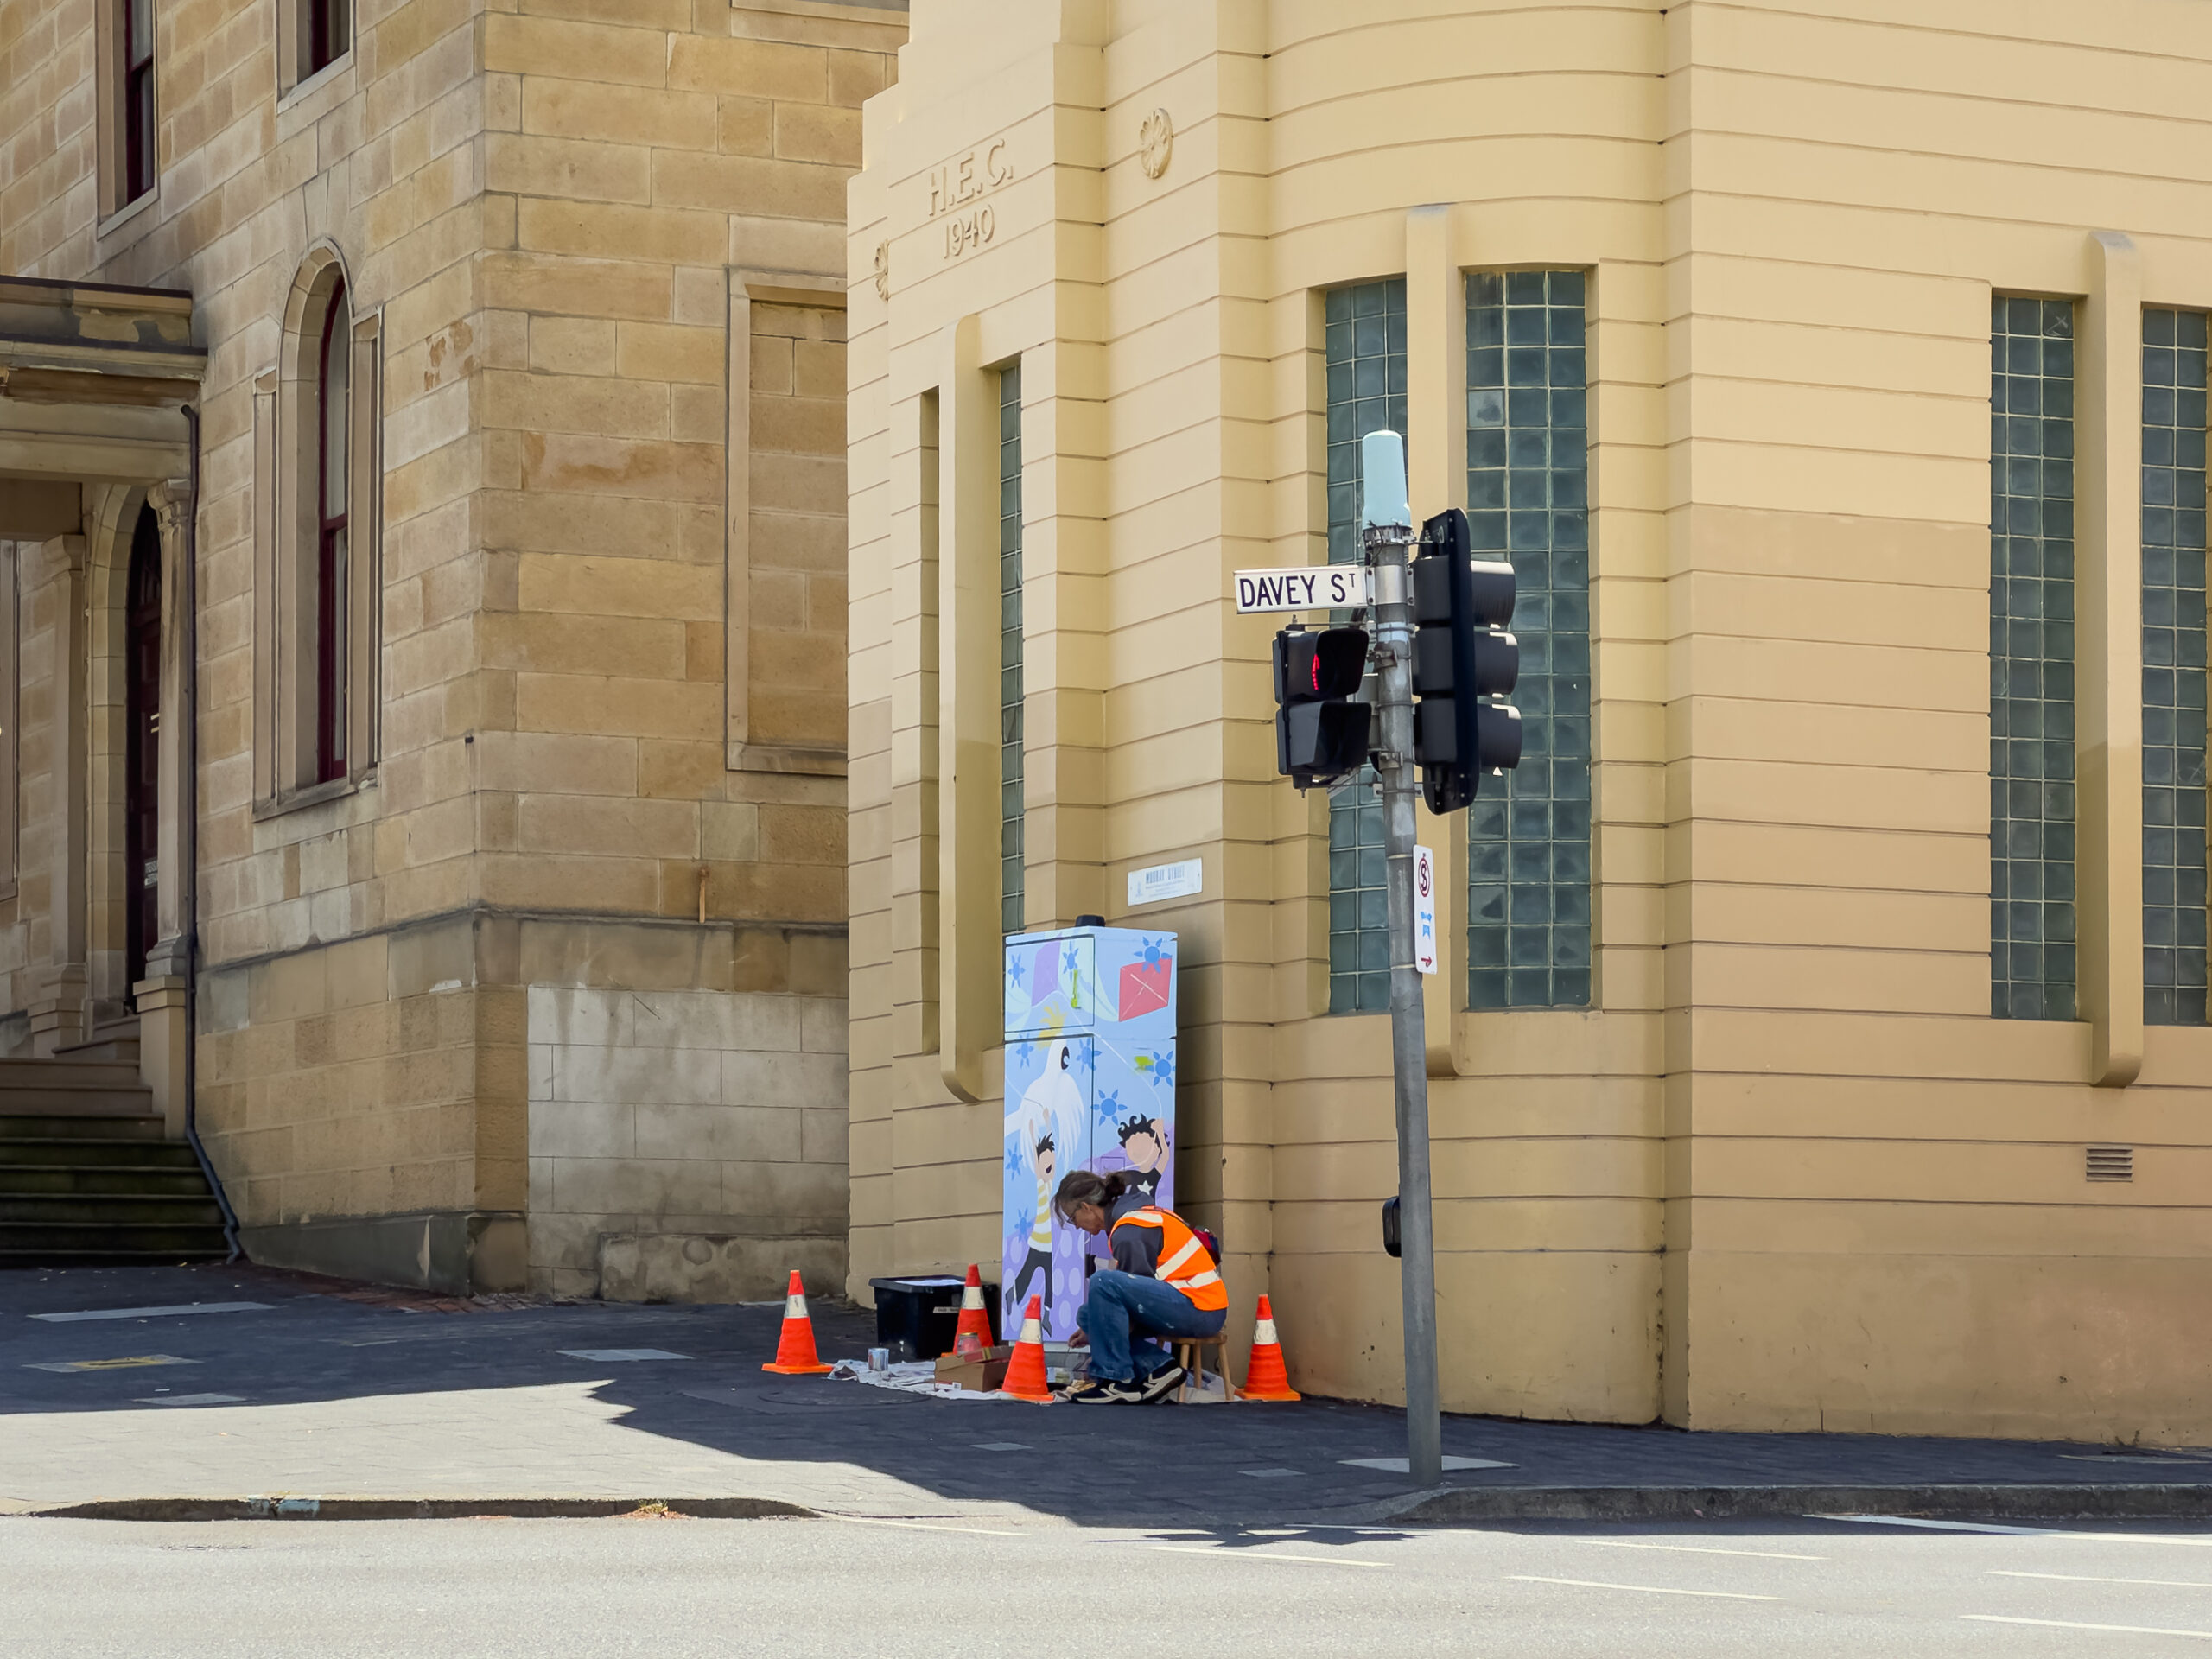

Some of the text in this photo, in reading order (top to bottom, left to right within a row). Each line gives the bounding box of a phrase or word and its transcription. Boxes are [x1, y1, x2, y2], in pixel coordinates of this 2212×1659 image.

[928, 137, 1014, 217] H.E.C.
[944, 203, 995, 259] 1940
[1239, 575, 1316, 607] DAVEY
